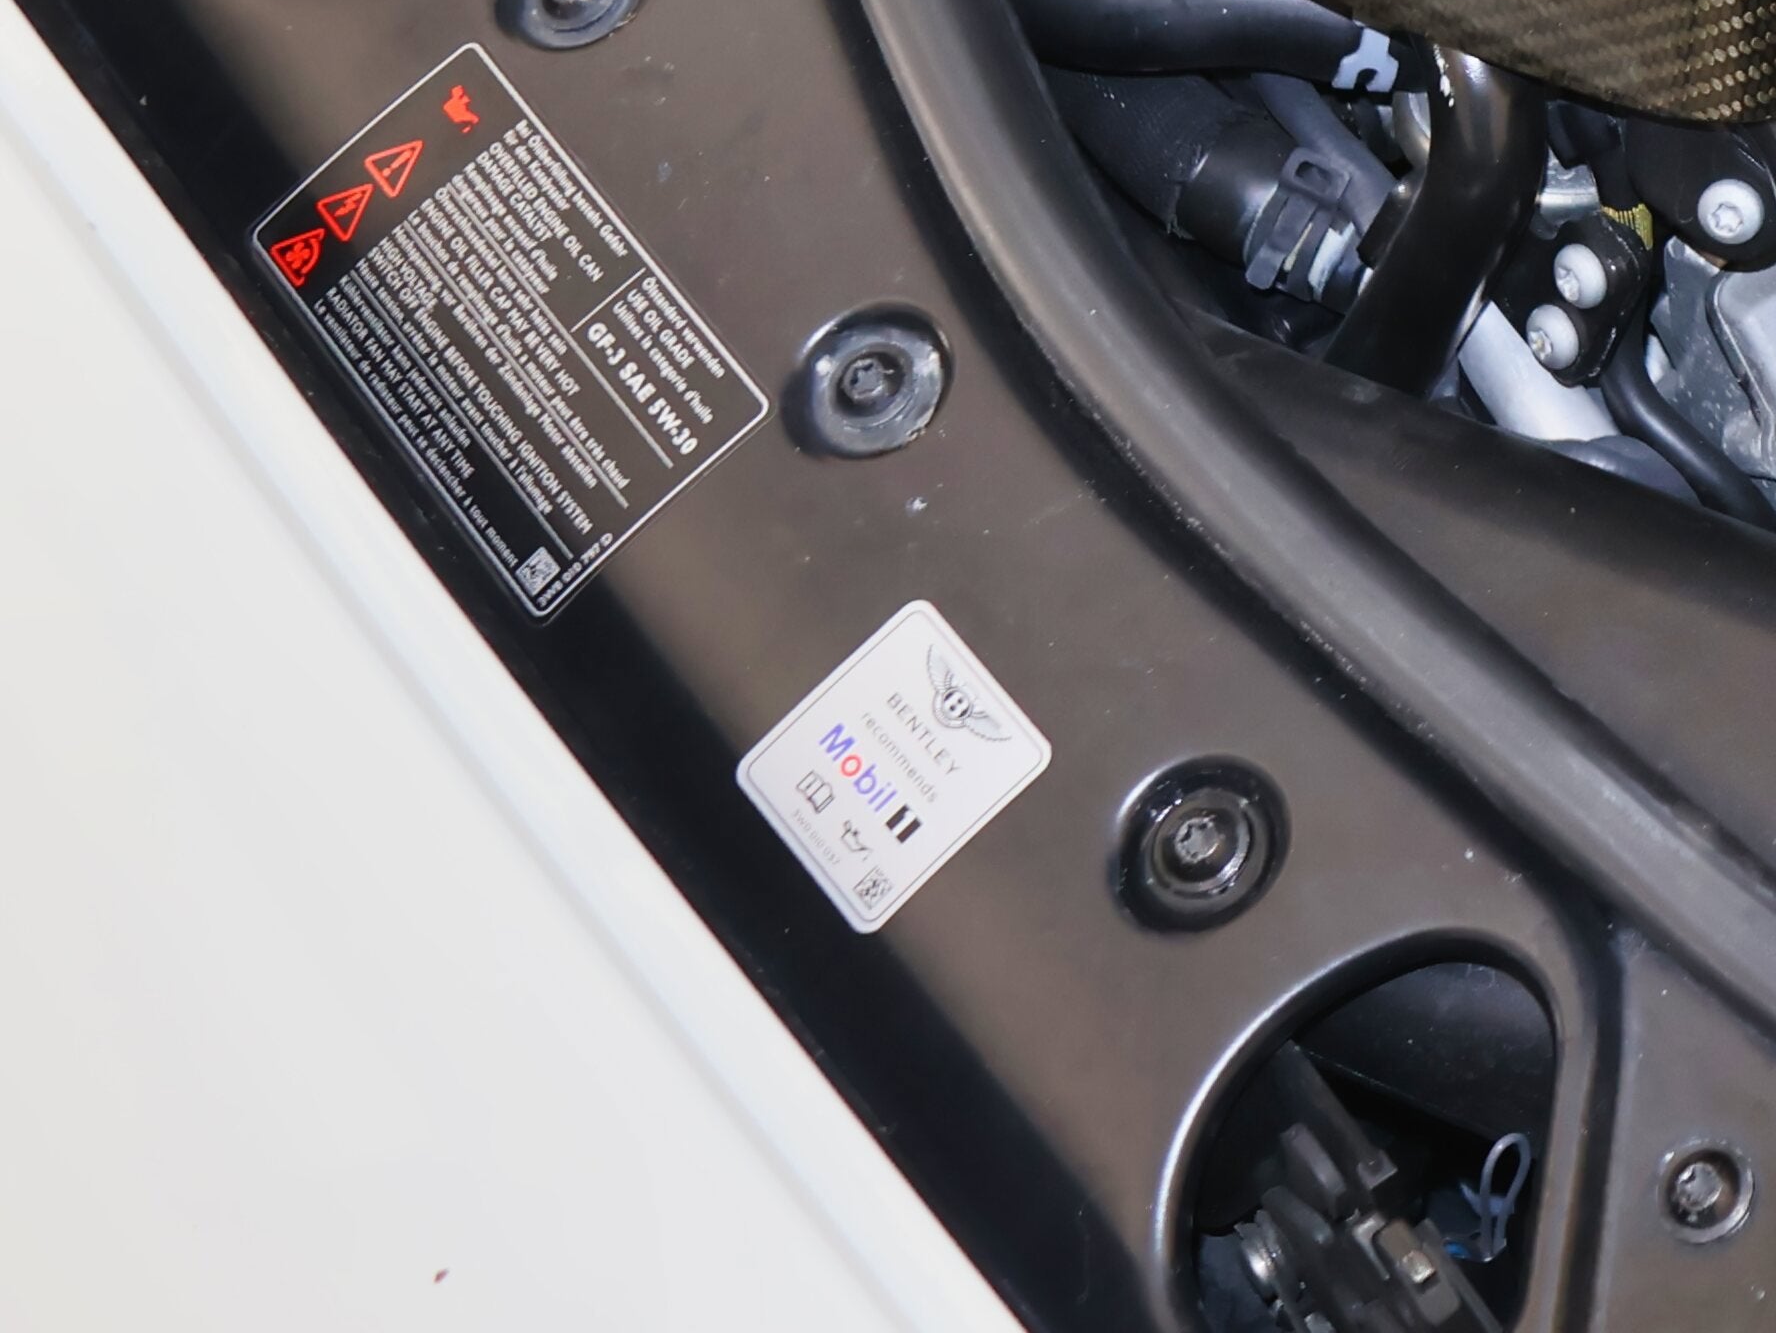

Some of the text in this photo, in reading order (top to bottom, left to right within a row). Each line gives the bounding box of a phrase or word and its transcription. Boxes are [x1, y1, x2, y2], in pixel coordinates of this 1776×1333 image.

[475, 150, 553, 241] DAMAGE CATALYST
[489, 141, 603, 281] OVERFILLED ENGINE OIL CAN
[378, 236, 404, 267] HIGH
[420, 197, 455, 239] ENGINE
[450, 236, 468, 258] OIL
[463, 254, 493, 290] FILLER
[489, 286, 512, 309] CAP
[506, 307, 530, 332] MAY
[535, 342, 561, 371] VERY
[554, 368, 579, 395] HOT
[417, 220, 449, 263] bouchon
[524, 361, 555, 395] moteur
[546, 395, 573, 424] peut
[601, 458, 630, 489] chaud
[627, 288, 694, 368] USE OIL GRADE
[681, 327, 724, 378] verwenden
[326, 286, 368, 340] RADIATOR
[364, 337, 385, 362] FAN
[380, 358, 402, 383] MAY
[397, 381, 426, 414] START
[431, 428, 455, 452] ANY
[450, 448, 474, 478] TIME
[367, 246, 592, 534] SWITCH OFF ENGINE BEFORE TOUCHING IGNITION SYSTEM
[587, 322, 697, 454] GF-3 SAE 5W-30
[683, 390, 712, 423] d'huile
[480, 422, 512, 459] toucher
[397, 413, 419, 437] peut
[469, 504, 488, 528] tout
[485, 526, 518, 567] moment
[819, 723, 896, 811] Mobil
[861, 712, 938, 801] recommends
[887, 694, 959, 776] BENTLEY
